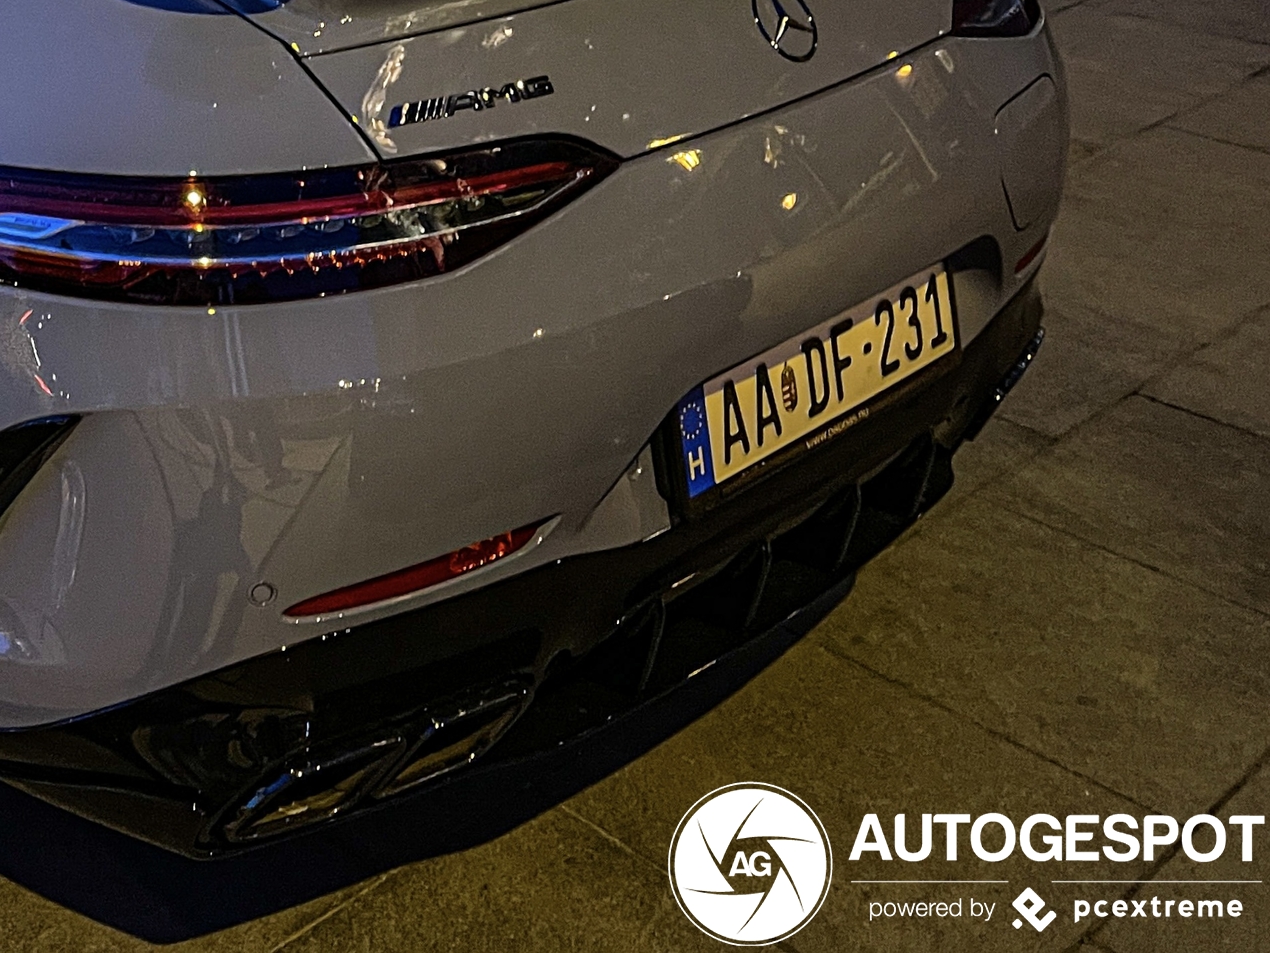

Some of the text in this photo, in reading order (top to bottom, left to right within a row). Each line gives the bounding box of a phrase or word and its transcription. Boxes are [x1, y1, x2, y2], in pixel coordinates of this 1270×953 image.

[444, 75, 554, 118] AMG
[723, 361, 782, 466] AA
[688, 446, 706, 481] H
